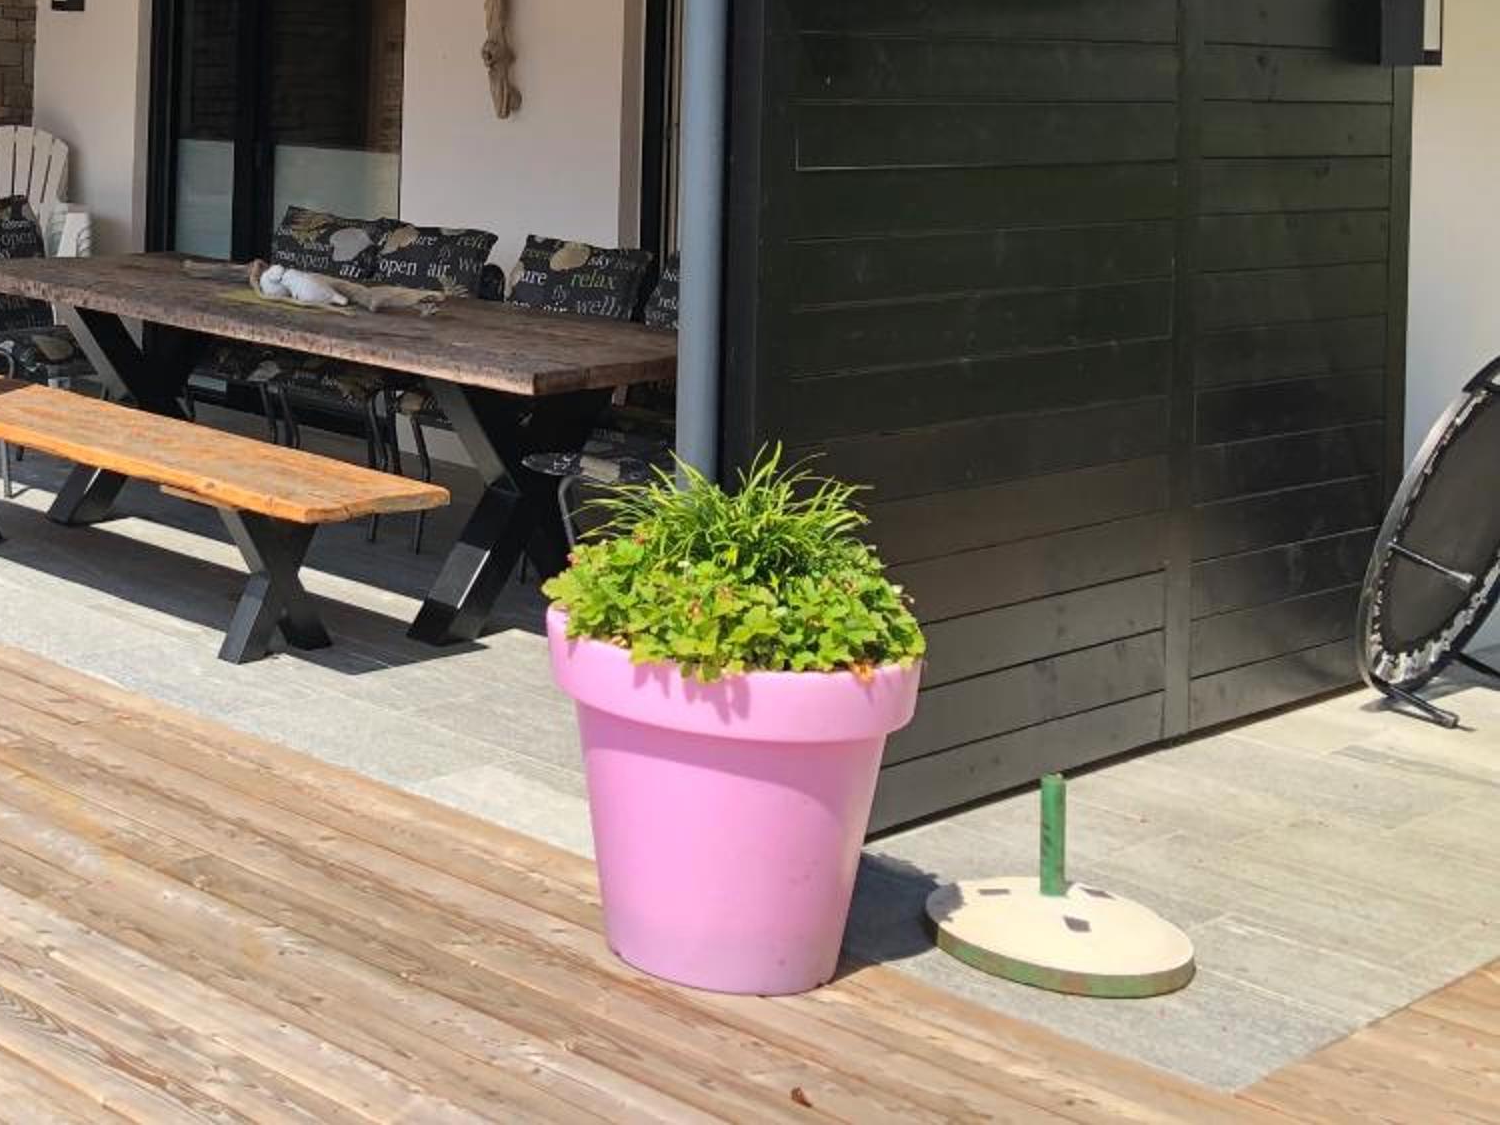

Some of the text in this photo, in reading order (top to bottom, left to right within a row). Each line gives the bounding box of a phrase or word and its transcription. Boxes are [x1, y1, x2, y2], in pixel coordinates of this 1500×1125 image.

[379, 258, 417, 277] open
[427, 259, 451, 279] air
[570, 269, 615, 290] relax
